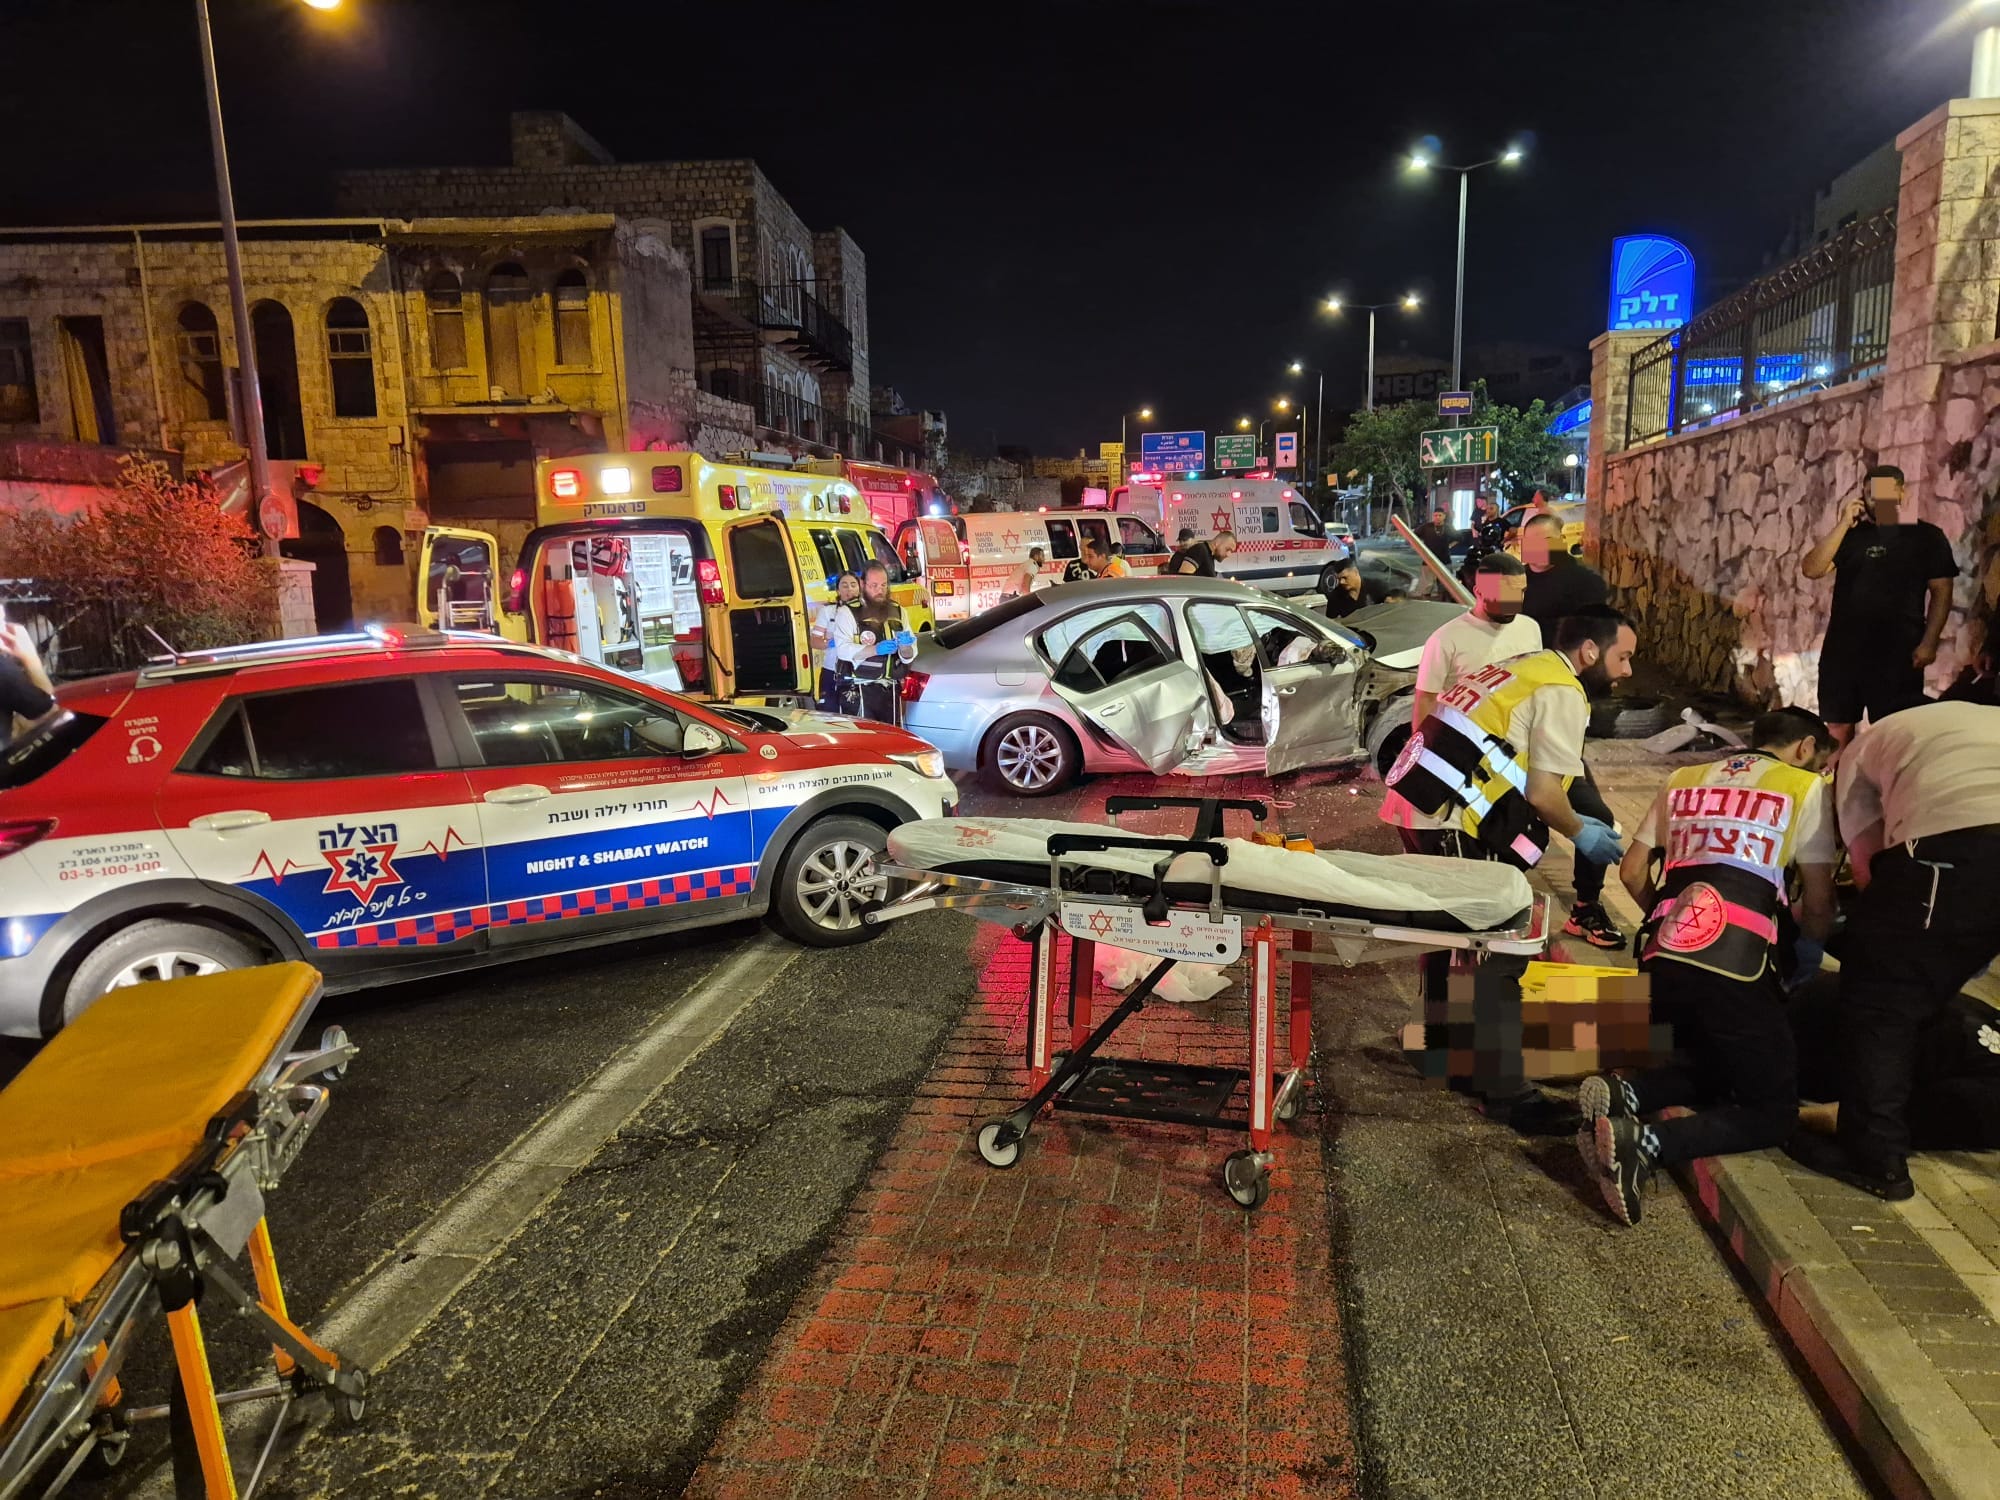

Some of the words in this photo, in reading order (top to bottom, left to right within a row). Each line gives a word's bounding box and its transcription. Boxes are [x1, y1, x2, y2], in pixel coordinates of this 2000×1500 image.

[1619, 290, 1679, 321] דלק
[773, 480, 791, 495] טיפול
[584, 501, 646, 517] פראמדיק
[1237, 507, 1247, 515] דוד
[1249, 507, 1260, 515] מגן
[1237, 526, 1261, 535] בישראל
[124, 716, 159, 727] במקרה
[128, 727, 157, 736] חירום
[127, 755, 144, 764] 101
[832, 773, 870, 785] מתנדבים
[872, 770, 893, 782] ארגון
[782, 782, 795, 790] חיי
[799, 777, 829, 790] להצלת
[758, 785, 778, 795] אדם
[594, 803, 627, 818] לילה
[633, 799, 668, 812] תורני
[1671, 788, 1785, 828] חובש
[548, 810, 588, 824] ושבת
[318, 822, 398, 850] הצלה
[110, 843, 143, 852] המרכז
[1671, 824, 1775, 865] הצלה
[72, 846, 106, 856] הארצי
[142, 851, 160, 860] רבי
[526, 856, 576, 874] NIGHT
[578, 854, 590, 866] &
[593, 845, 652, 865] SHABAT
[655, 836, 709, 855] WATCH
[80, 857, 101, 866] 106
[103, 853, 139, 863] עקיבא
[59, 860, 161, 881] 03-5-100-100
[397, 885, 412, 907] כל
[414, 892, 427, 900] כי
[368, 894, 394, 918] שניה
[323, 906, 365, 928] קובעת
